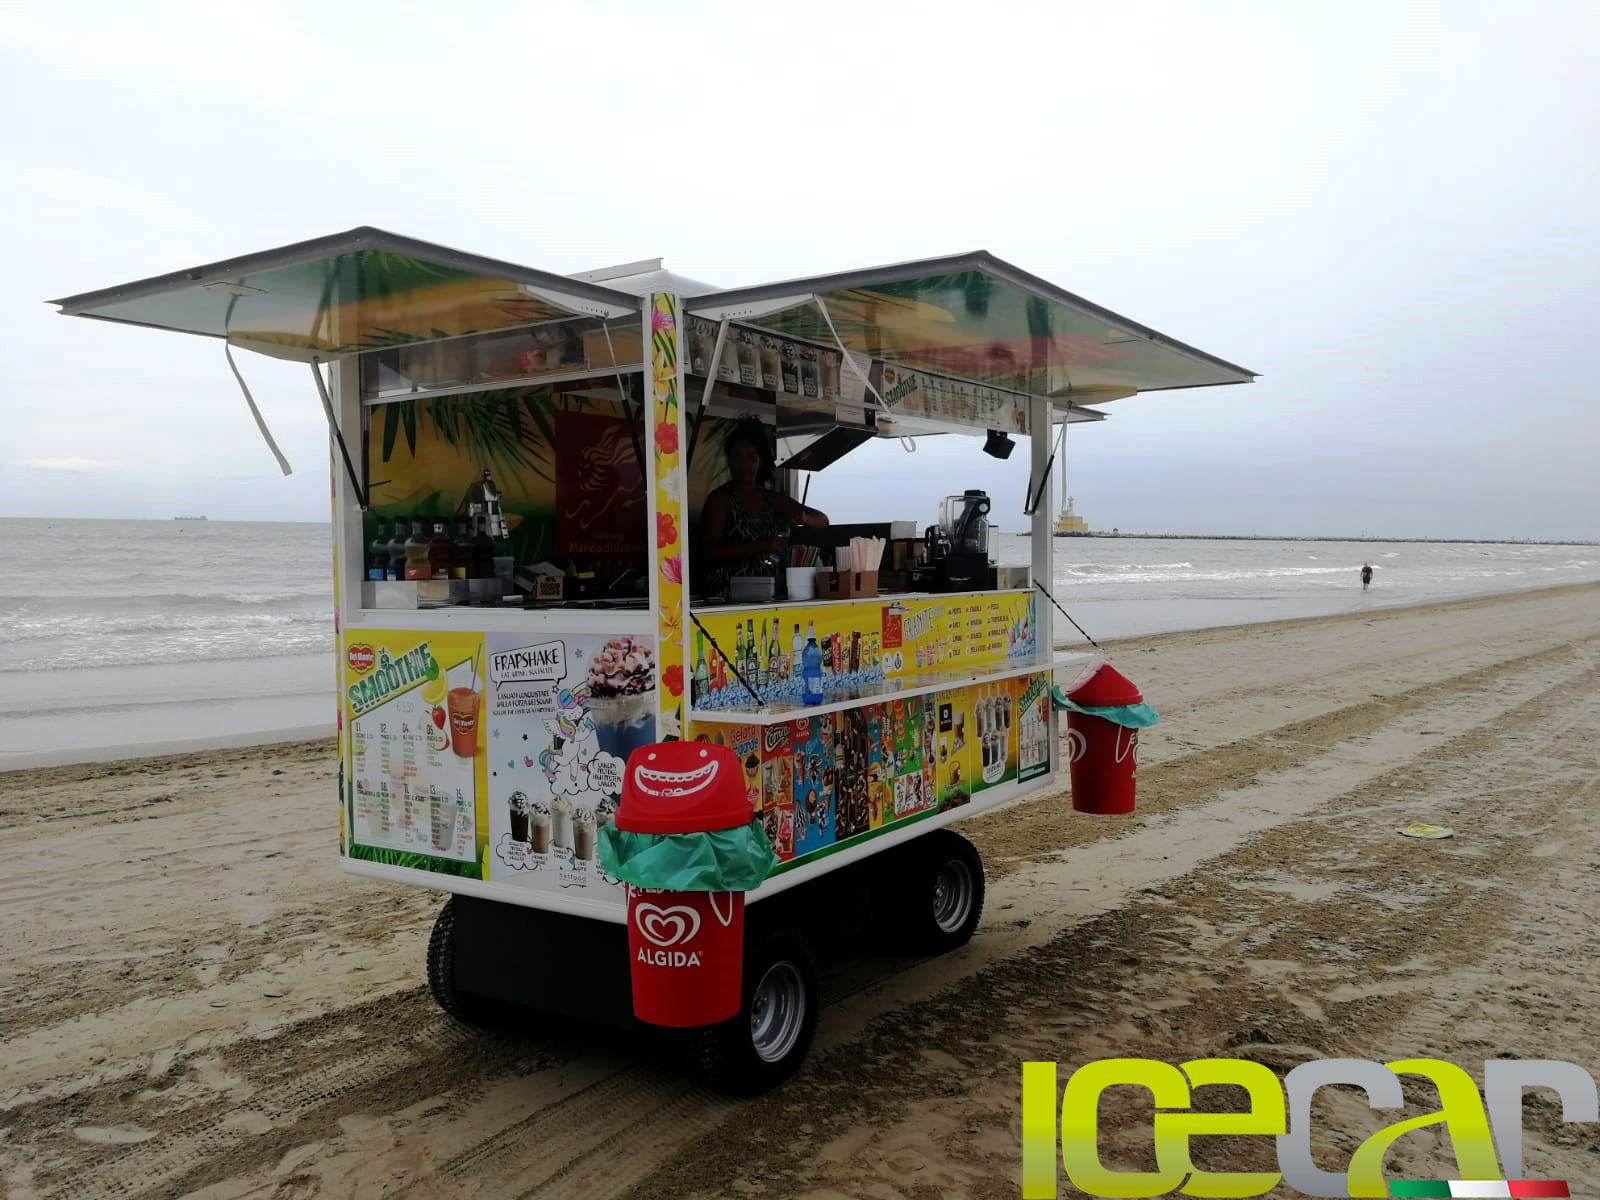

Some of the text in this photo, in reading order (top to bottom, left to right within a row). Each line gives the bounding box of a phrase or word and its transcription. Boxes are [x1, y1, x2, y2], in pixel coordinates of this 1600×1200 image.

[494, 648, 560, 672] FRAPSHAKE
[349, 643, 431, 713] SMOOTHIE
[730, 726, 755, 744] Gelato
[637, 947, 701, 967] ALGIDA
